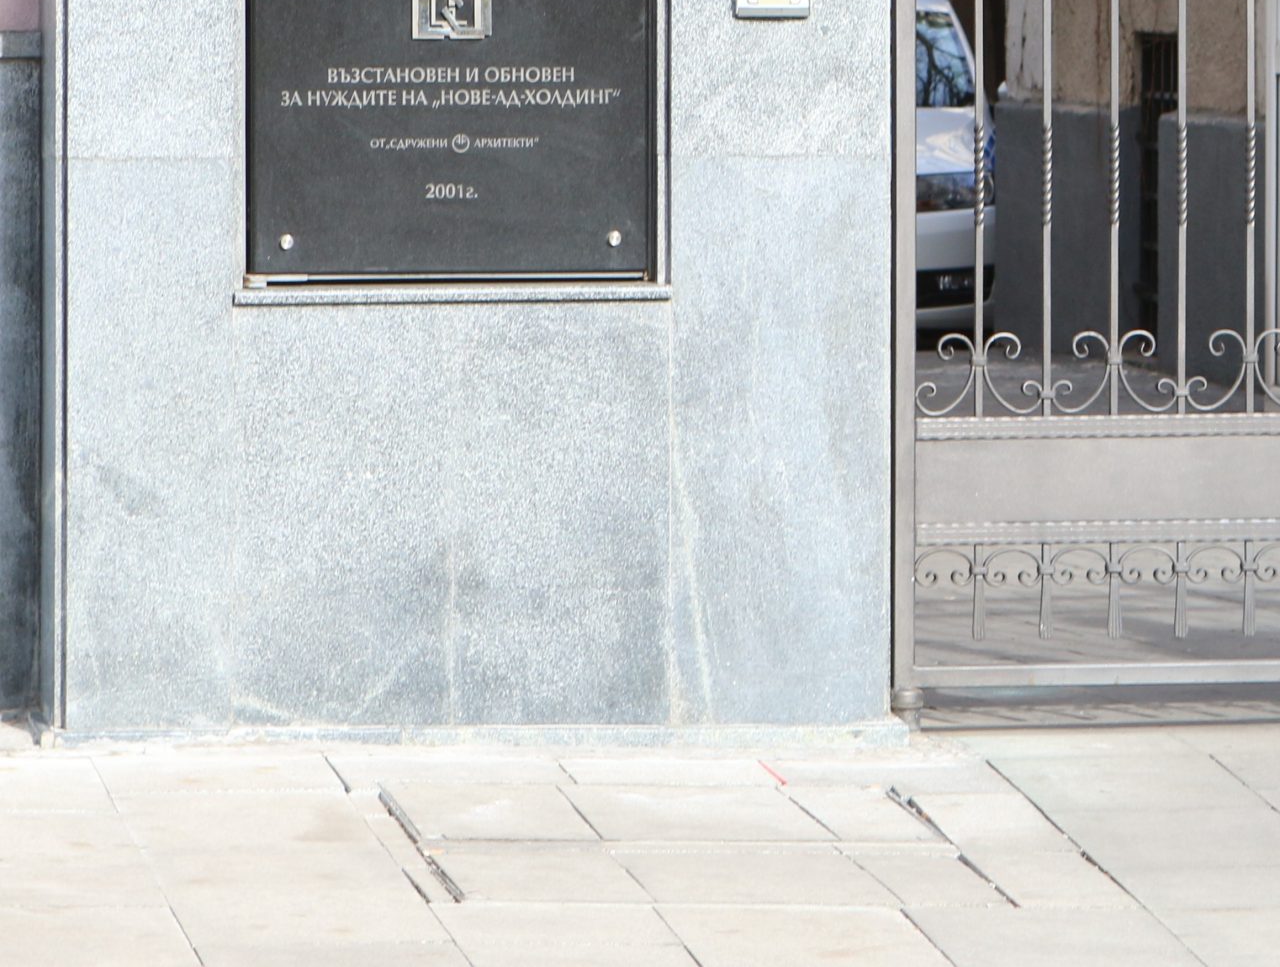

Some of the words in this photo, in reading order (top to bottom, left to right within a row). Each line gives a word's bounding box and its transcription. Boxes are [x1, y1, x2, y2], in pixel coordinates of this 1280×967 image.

[327, 66, 461, 85] ВЪЗСТАНОВЕН
[465, 66, 480, 84] И
[483, 65, 575, 84] ОБНОВЕН
[280, 89, 304, 108] ЗА
[307, 89, 397, 110] НУЖДИТЕ
[401, 88, 429, 107] НА
